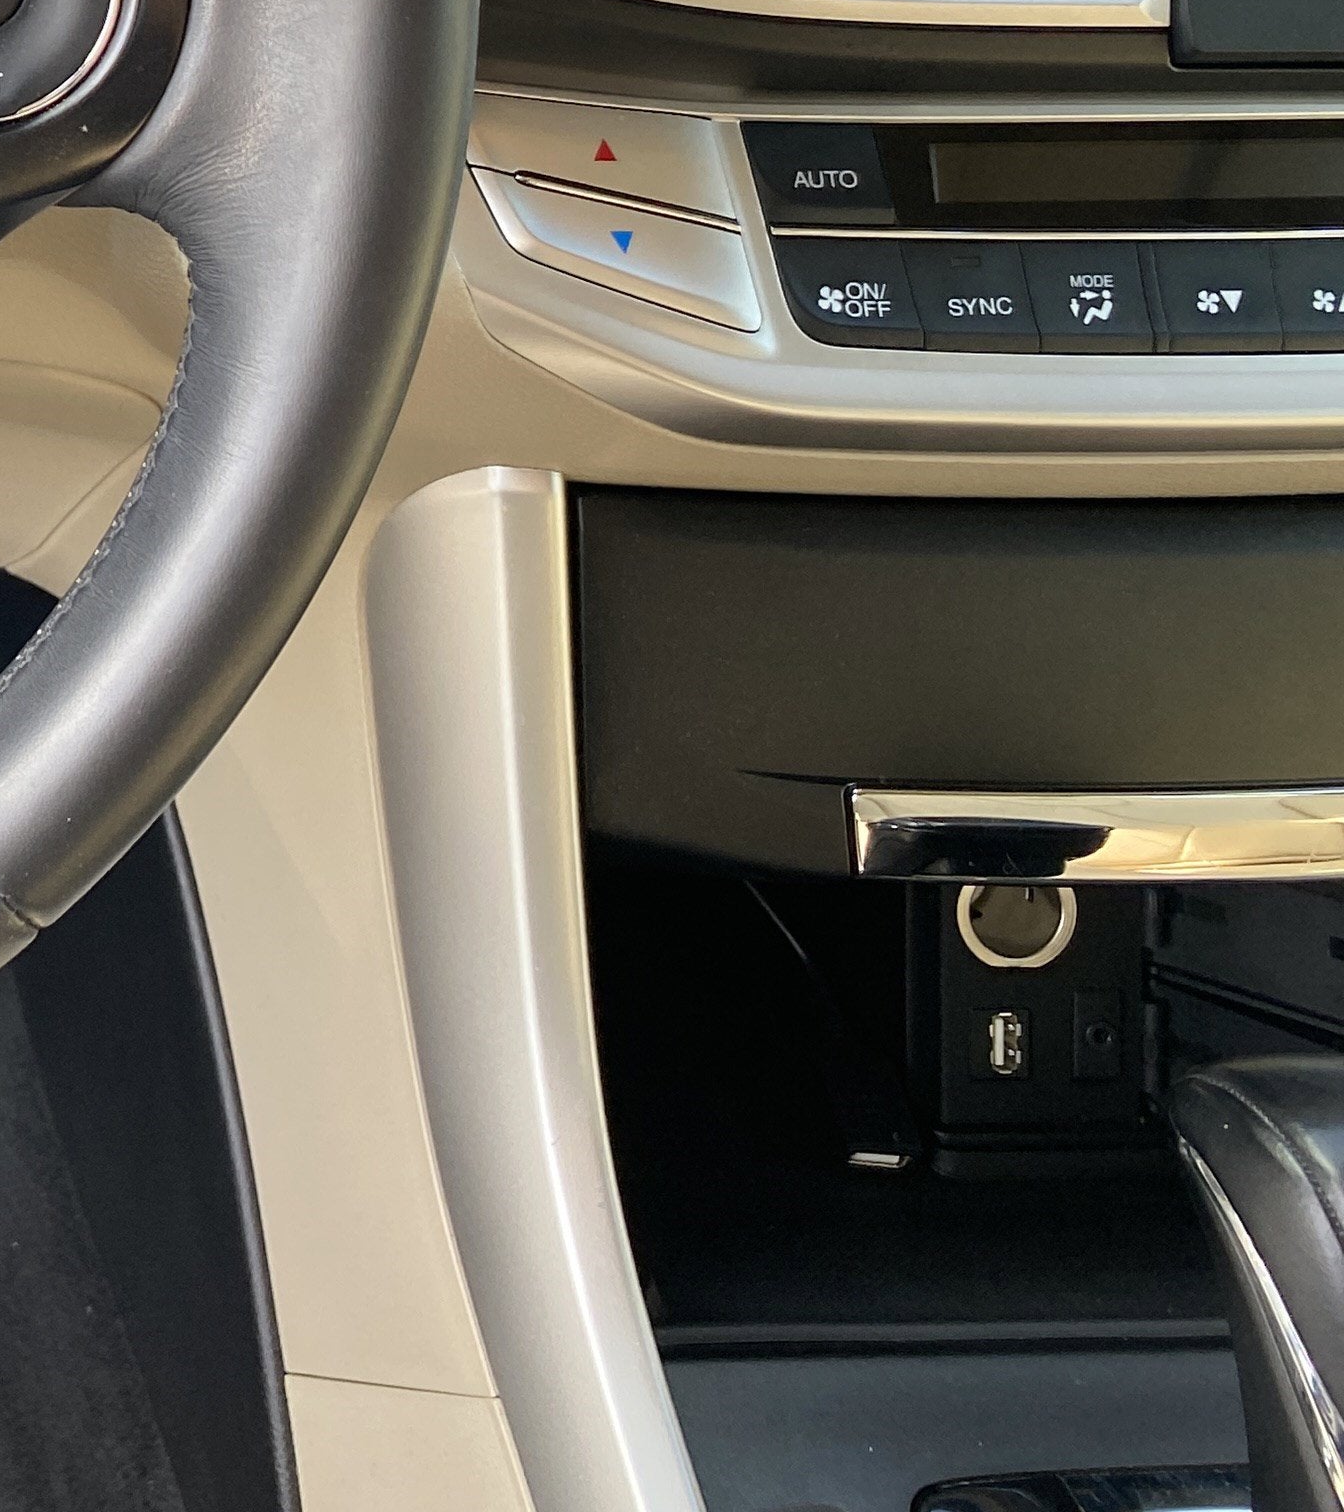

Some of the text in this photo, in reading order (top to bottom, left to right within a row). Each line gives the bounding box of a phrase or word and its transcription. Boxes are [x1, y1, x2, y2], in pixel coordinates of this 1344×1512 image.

[794, 170, 858, 189] AUTO
[1070, 274, 1113, 288] MODE
[845, 281, 886, 301] ON/
[845, 299, 891, 318] OFF
[948, 296, 1013, 317] SYNC
